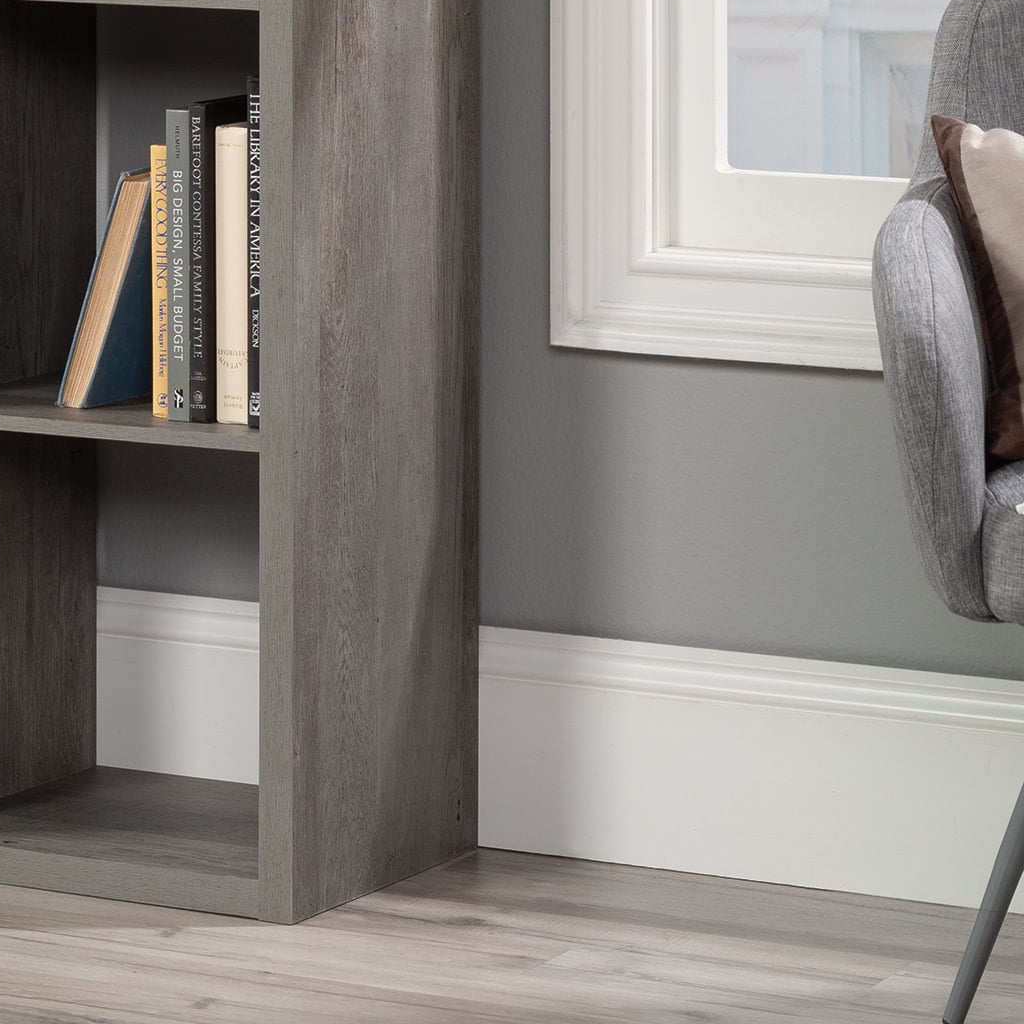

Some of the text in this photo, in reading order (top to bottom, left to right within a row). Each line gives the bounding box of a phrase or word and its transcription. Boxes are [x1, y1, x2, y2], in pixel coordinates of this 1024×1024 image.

[191, 115, 202, 189] BAREFOOT
[249, 128, 260, 194] LIBRARY
[192, 190, 202, 262] CONTESSA
[249, 197, 260, 217] IN
[171, 169, 184, 363] BIG DESIGN, SMALL BUDGET
[192, 264, 203, 314] FAMILY
[249, 220, 260, 298] AMERICA
[192, 316, 203, 359] STYLE
[251, 308, 260, 349] DICKSON
